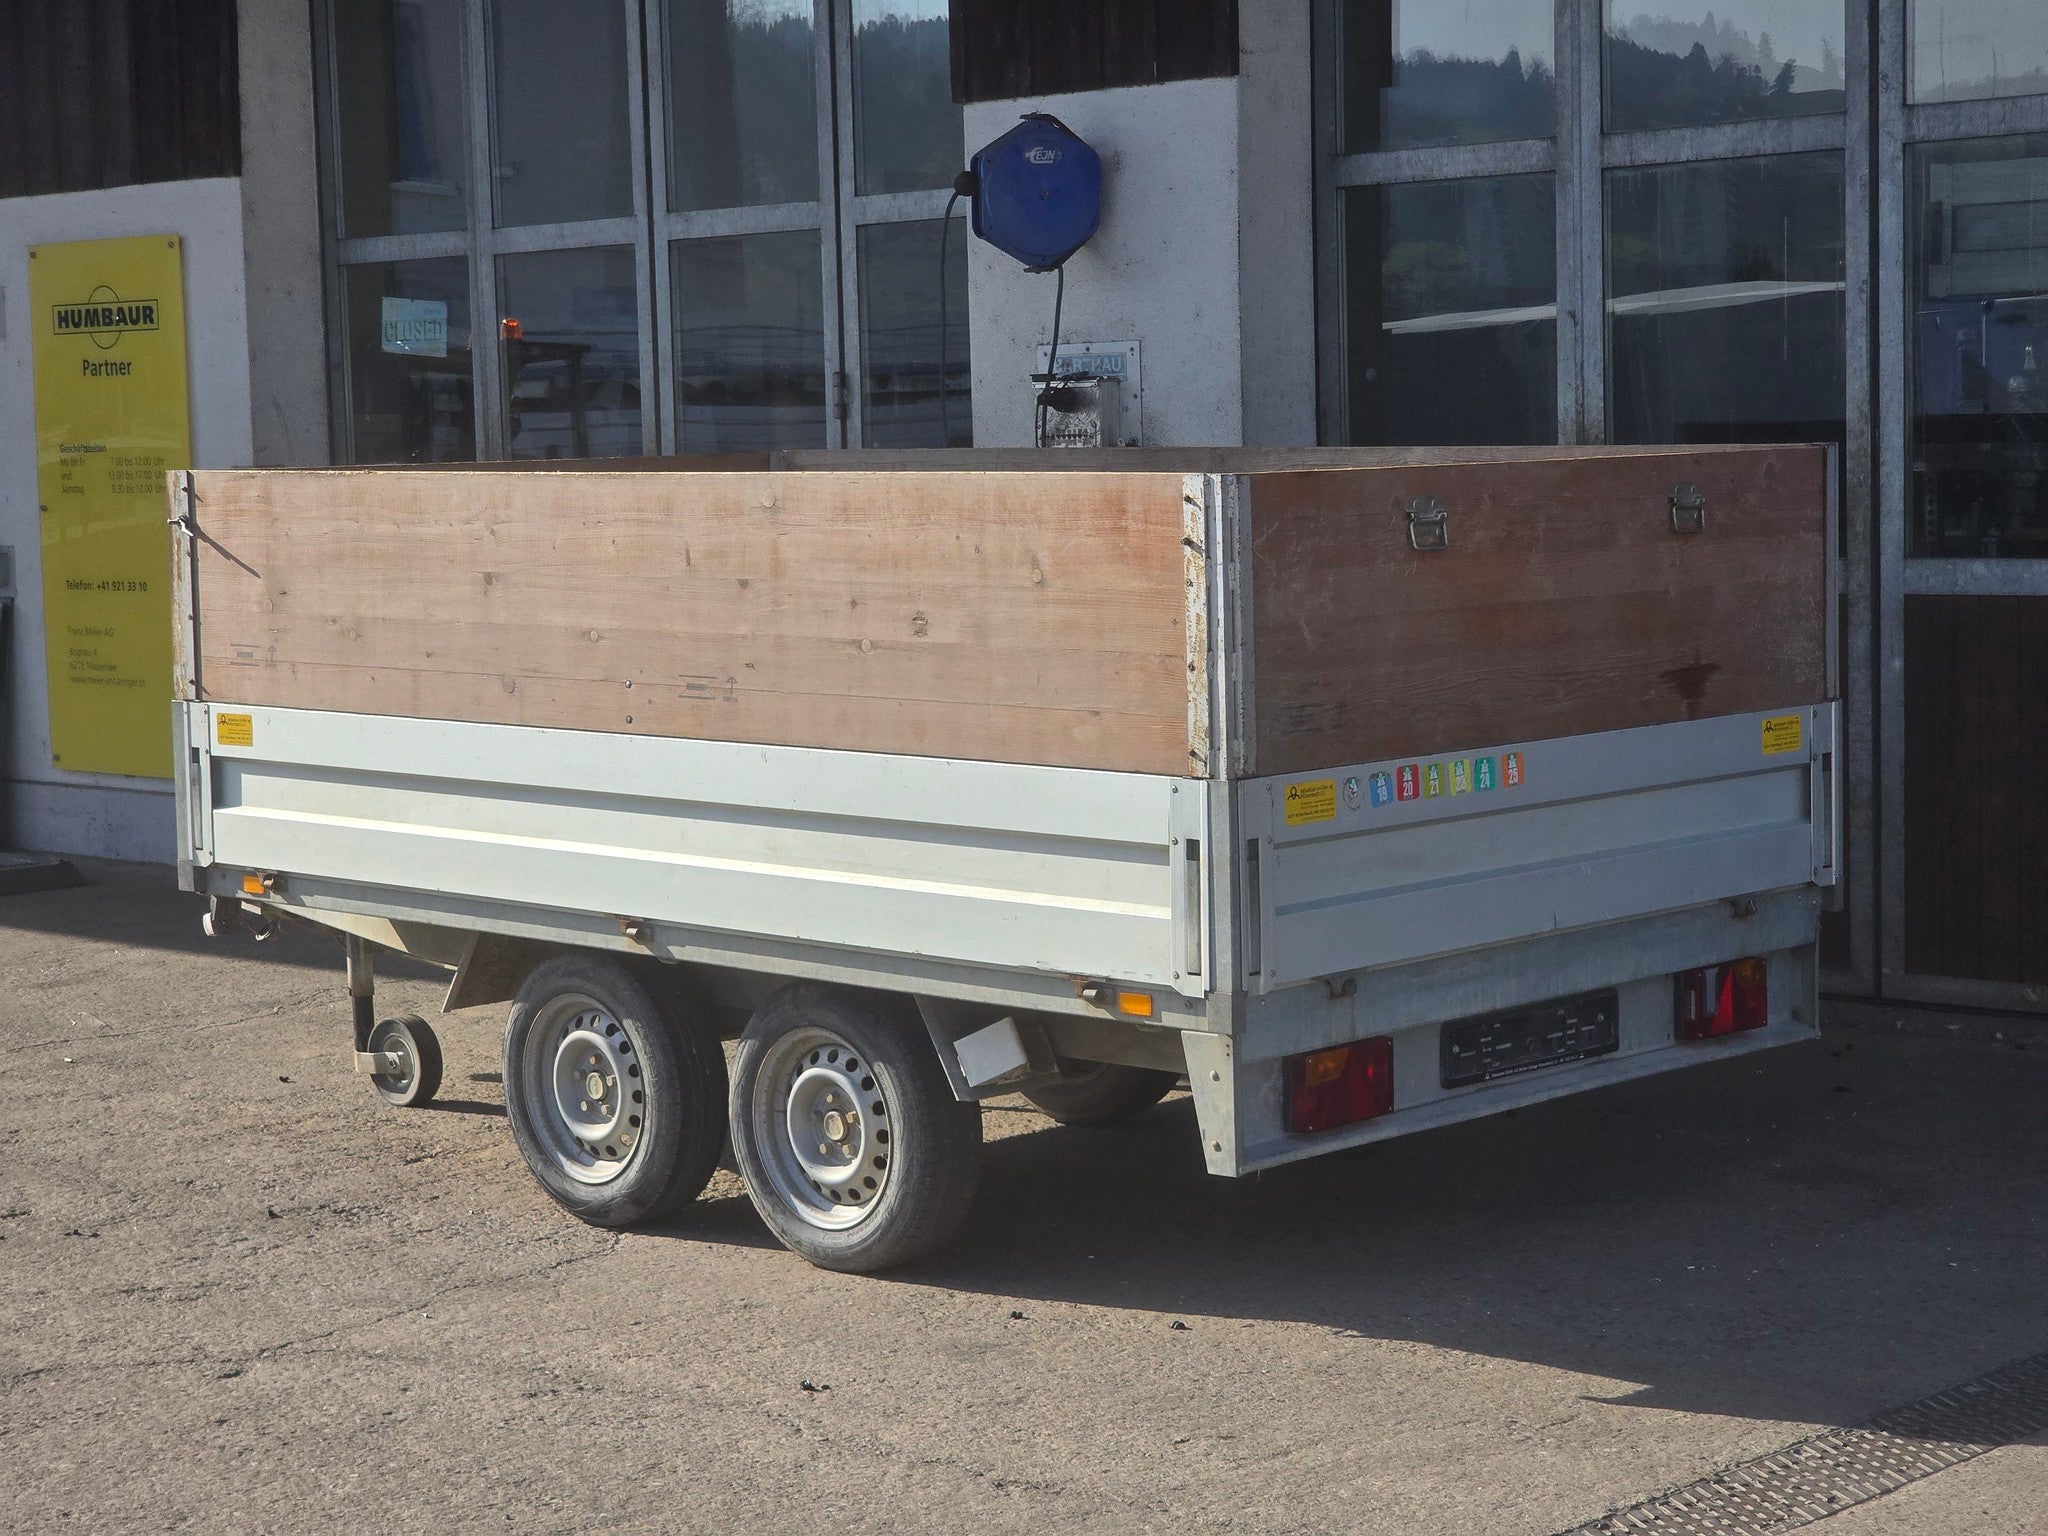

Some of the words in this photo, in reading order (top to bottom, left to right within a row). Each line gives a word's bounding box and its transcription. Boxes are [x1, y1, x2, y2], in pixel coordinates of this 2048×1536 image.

[57, 305, 155, 329] HUMBAUR
[385, 319, 442, 342] CLOSED
[82, 359, 132, 377] Partner
[66, 579, 94, 591] Telefon:
[97, 581, 110, 591] +41
[112, 581, 125, 592] 921
[128, 581, 137, 592] 33
[139, 581, 148, 592] 10
[1480, 773, 1490, 789] 24
[1508, 768, 1519, 786] 25
[1377, 785, 1388, 802] 19
[1403, 781, 1414, 797] 20
[1430, 779, 1439, 795] 21
